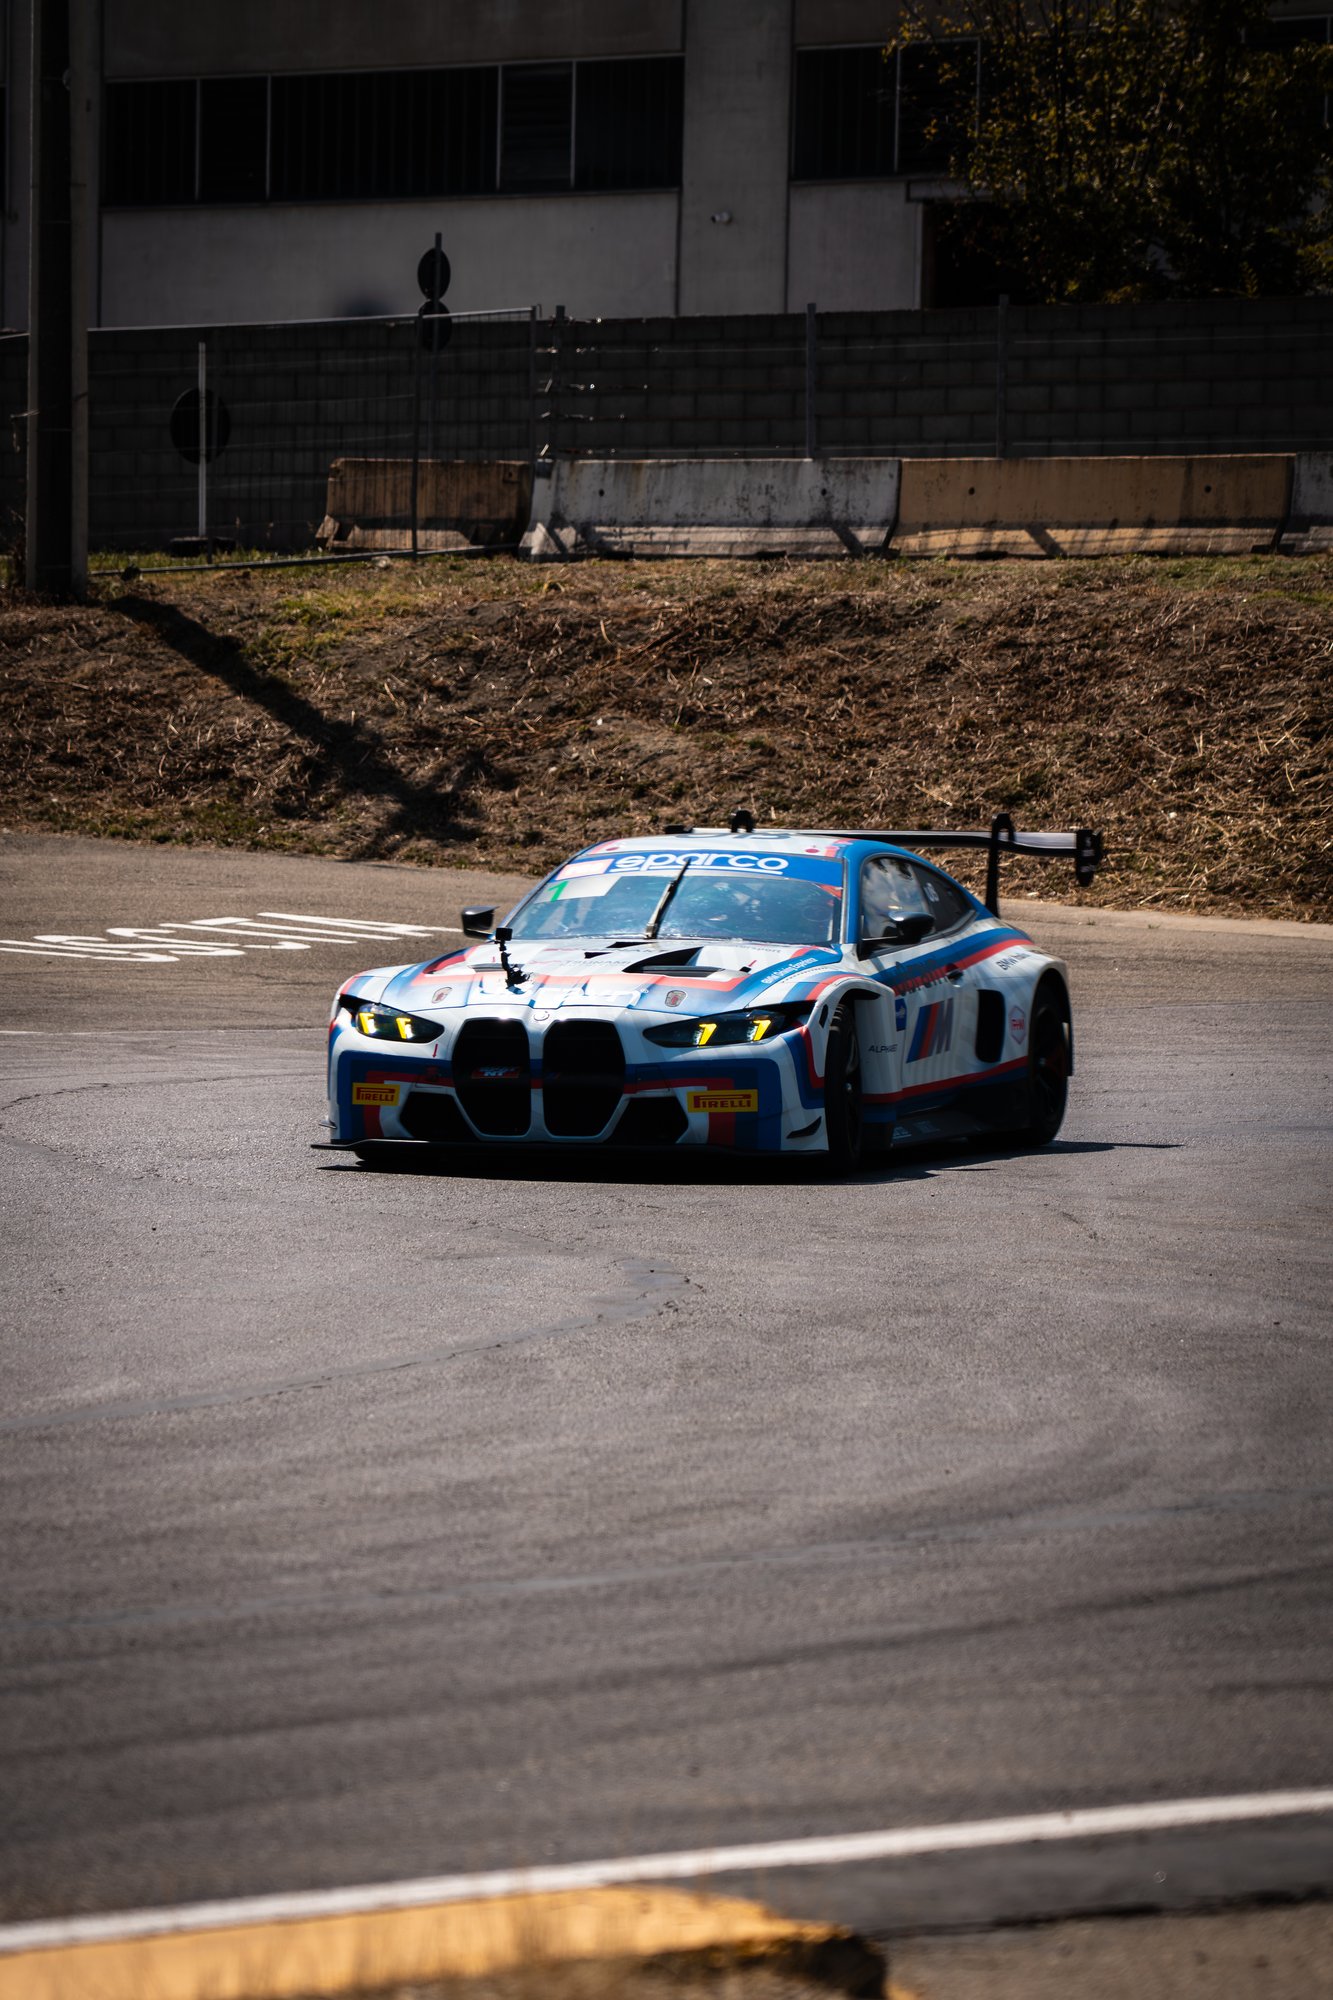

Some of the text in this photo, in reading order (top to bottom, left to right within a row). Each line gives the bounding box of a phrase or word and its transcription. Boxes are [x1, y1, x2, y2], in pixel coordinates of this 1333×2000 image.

[615, 852, 789, 872] sparco
[547, 881, 569, 902] 1
[356, 1086, 396, 1102] PIRELLI
[693, 1094, 752, 1108] PIRELLI
